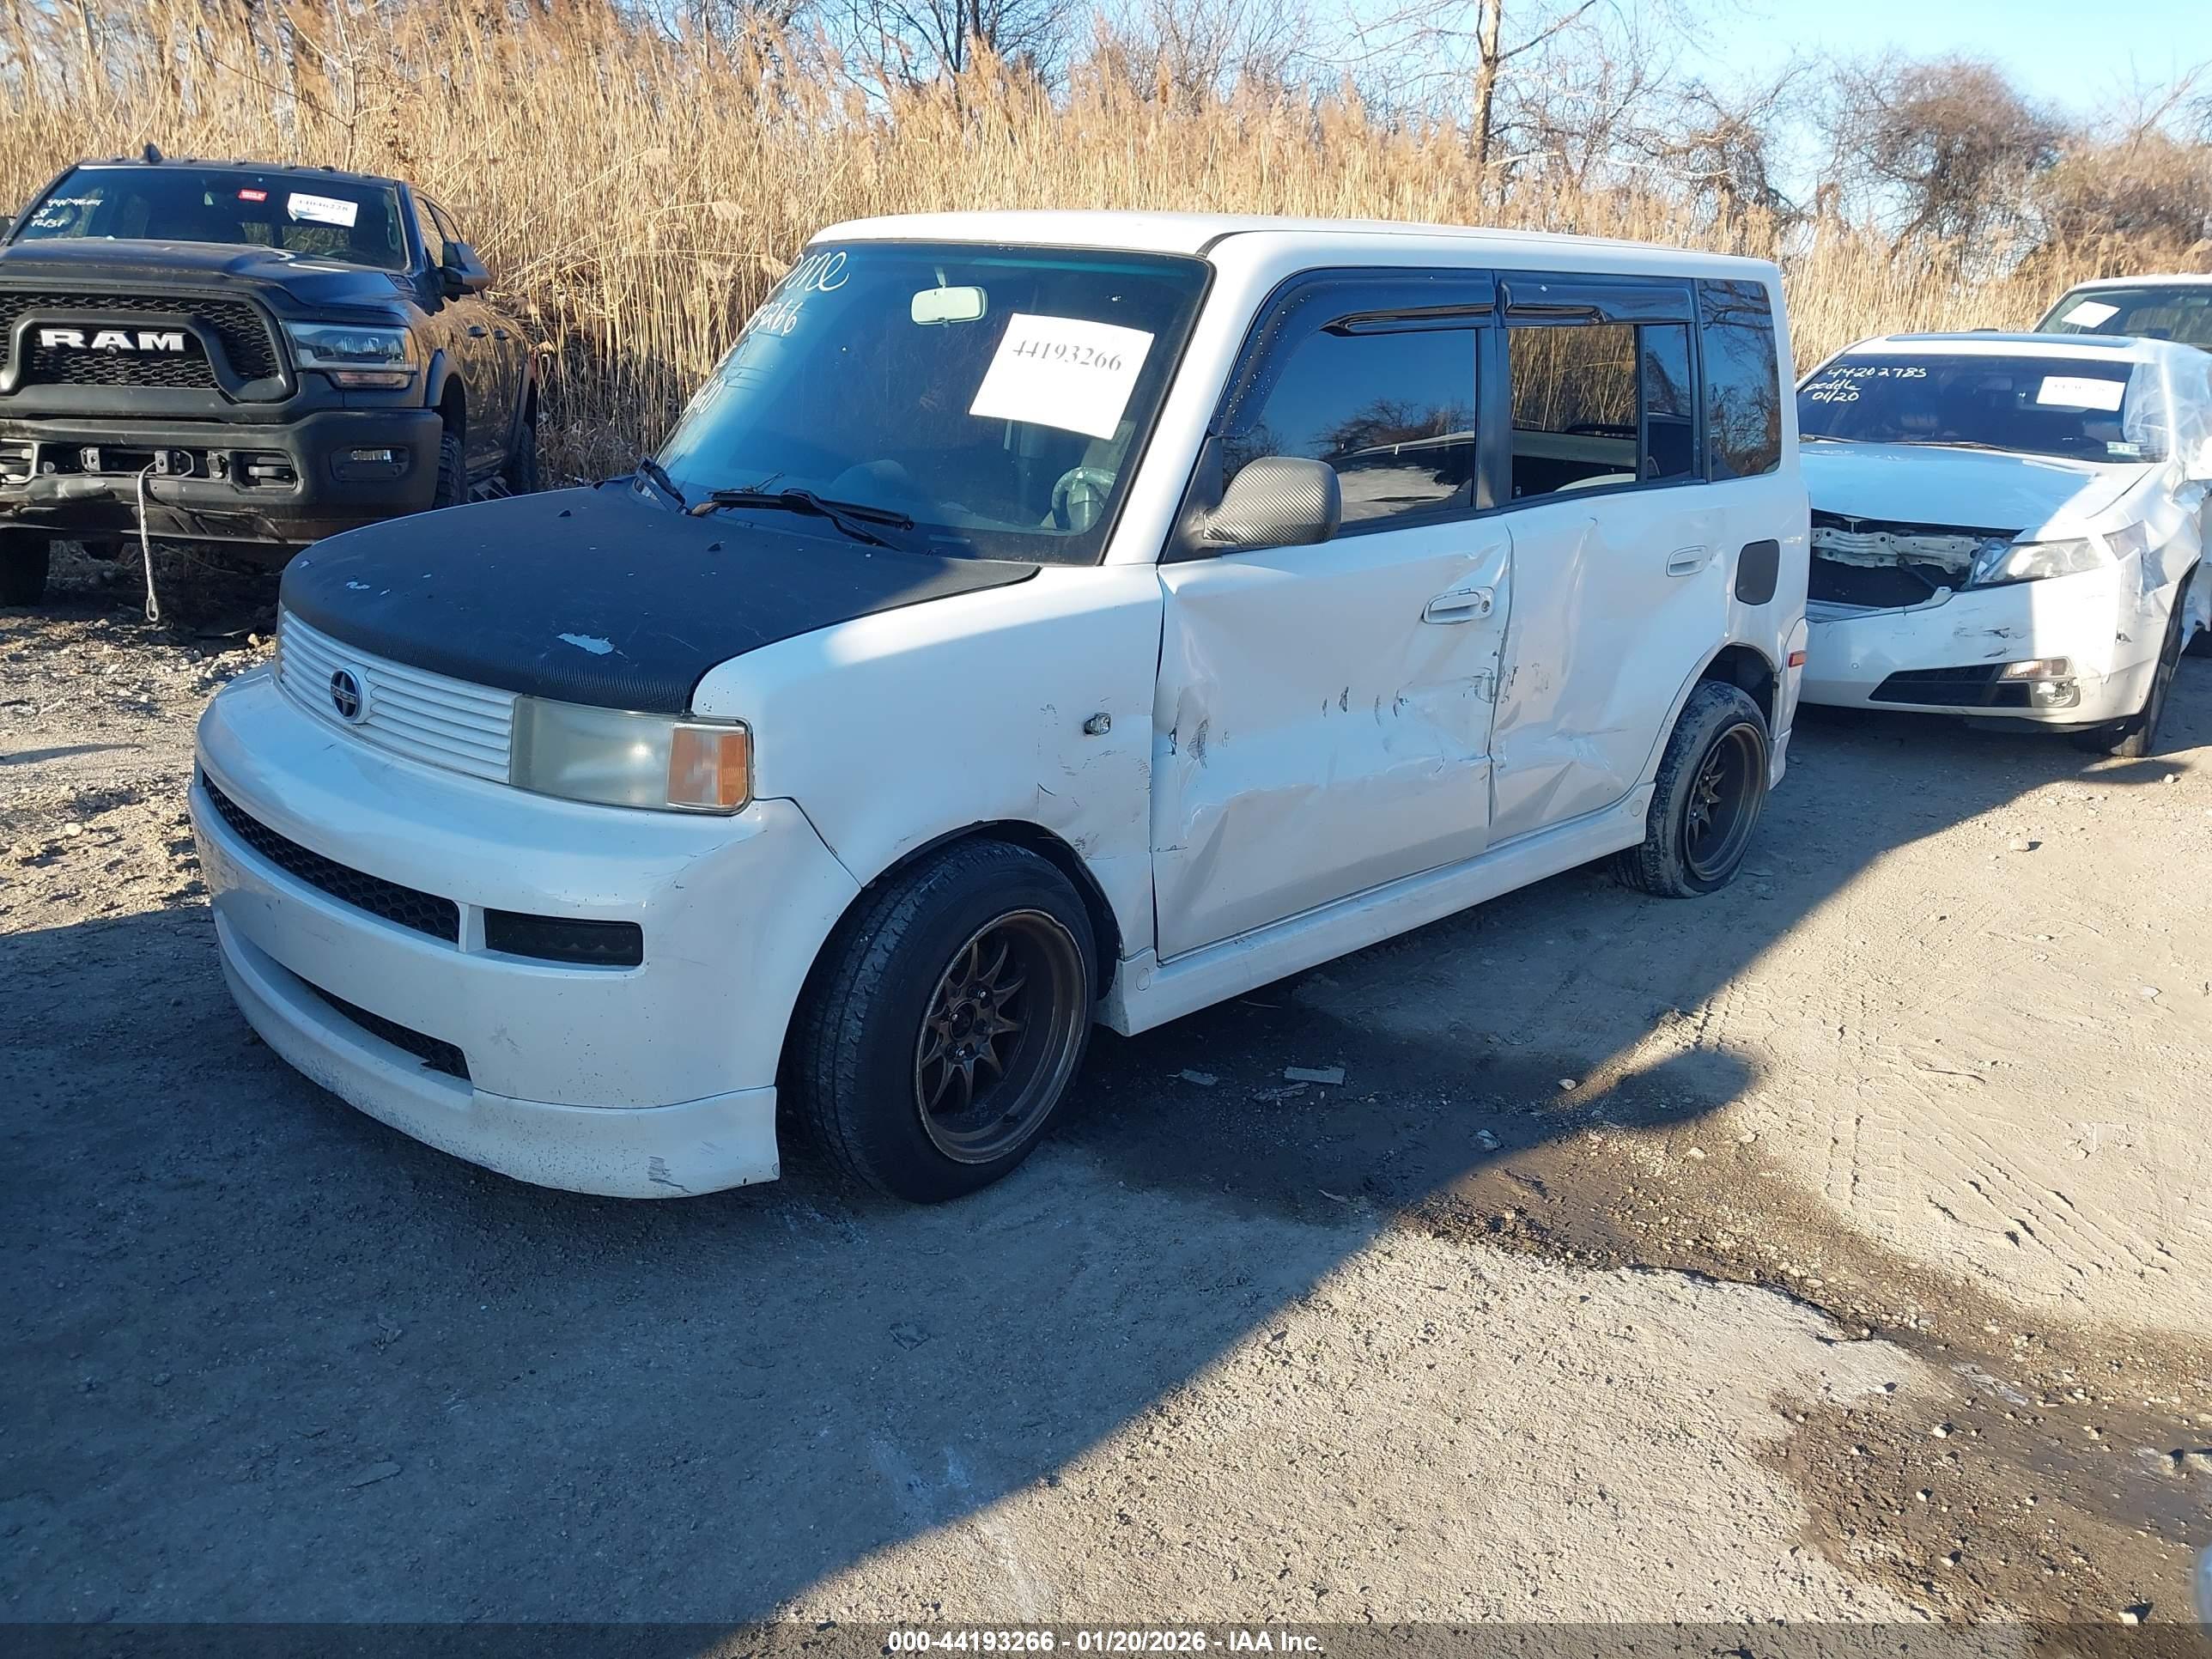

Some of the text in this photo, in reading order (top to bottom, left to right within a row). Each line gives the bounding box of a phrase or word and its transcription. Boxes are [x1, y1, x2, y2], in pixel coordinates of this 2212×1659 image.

[40, 330, 186, 351] RAM
[1012, 340, 1121, 371] 44193266
[1812, 390, 1860, 404] 01/20
